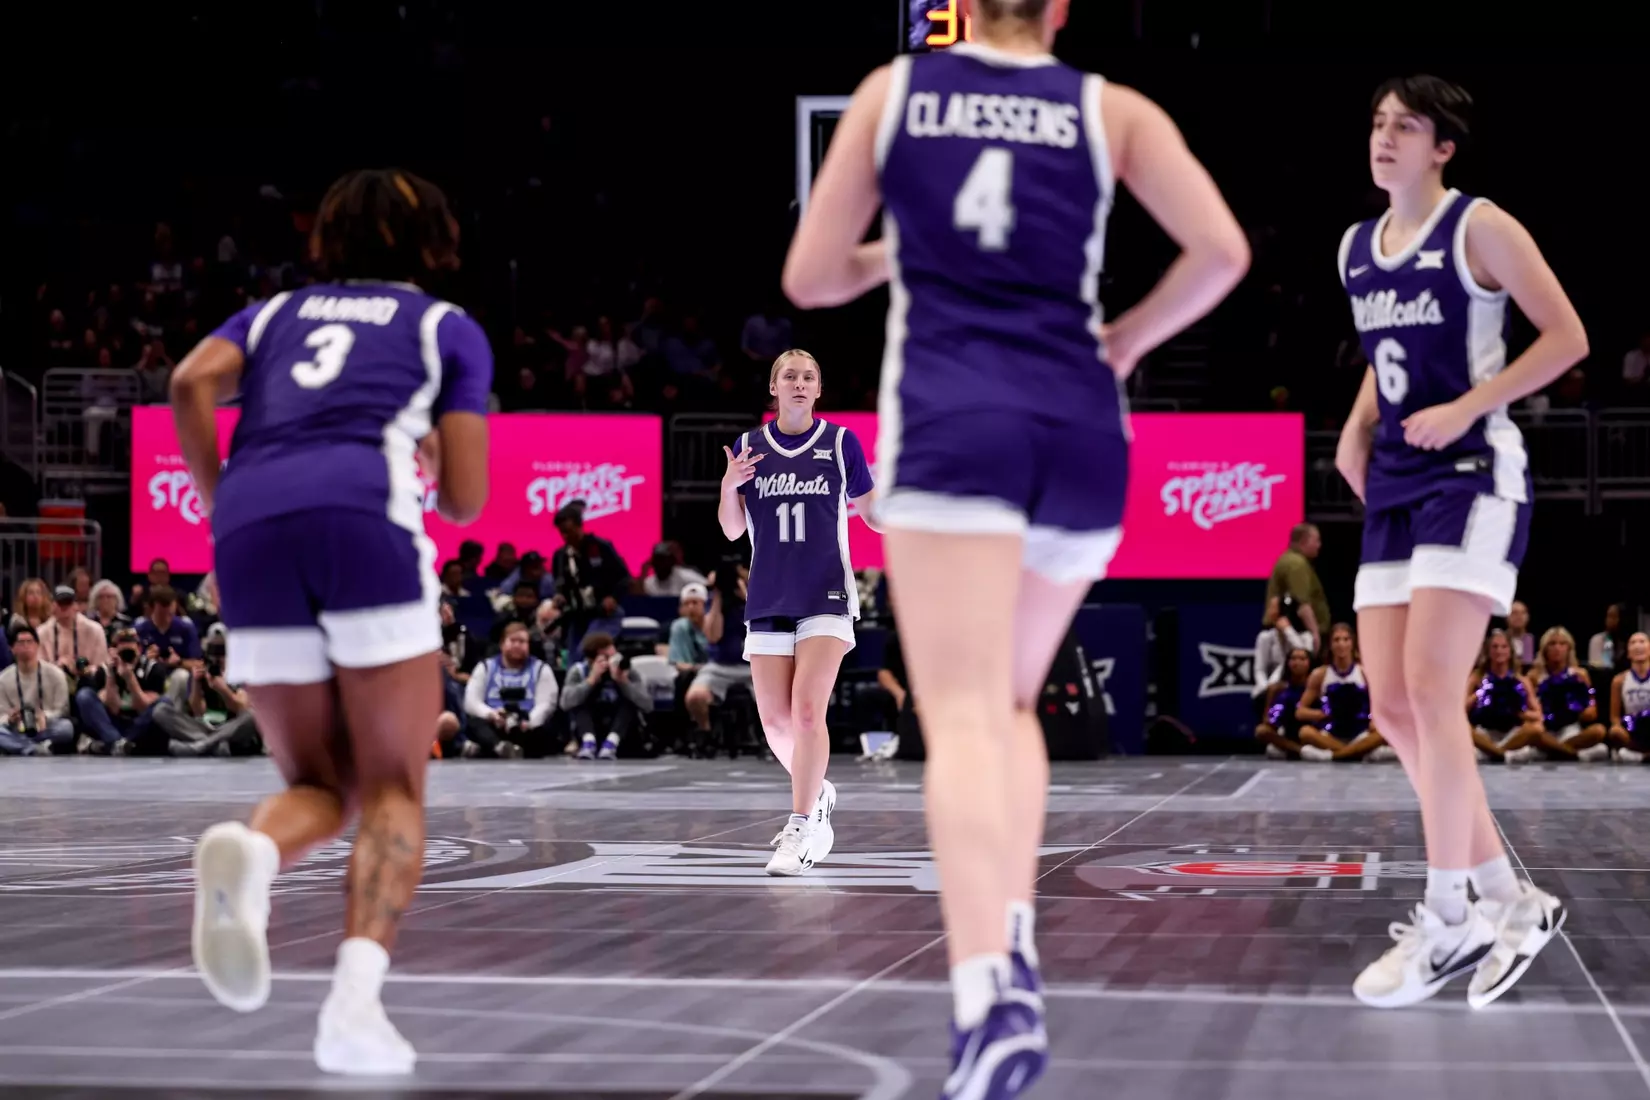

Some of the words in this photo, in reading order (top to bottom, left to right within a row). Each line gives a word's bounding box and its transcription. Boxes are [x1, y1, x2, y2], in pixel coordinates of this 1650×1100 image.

[907, 92, 1078, 148] CLAESSENS
[954, 148, 1016, 250] 4
[291, 323, 355, 389] 3
[1375, 338, 1408, 405] 6
[755, 472, 831, 500] Wildcats
[1160, 462, 1266, 516] SPORTS
[776, 501, 806, 543] 11
